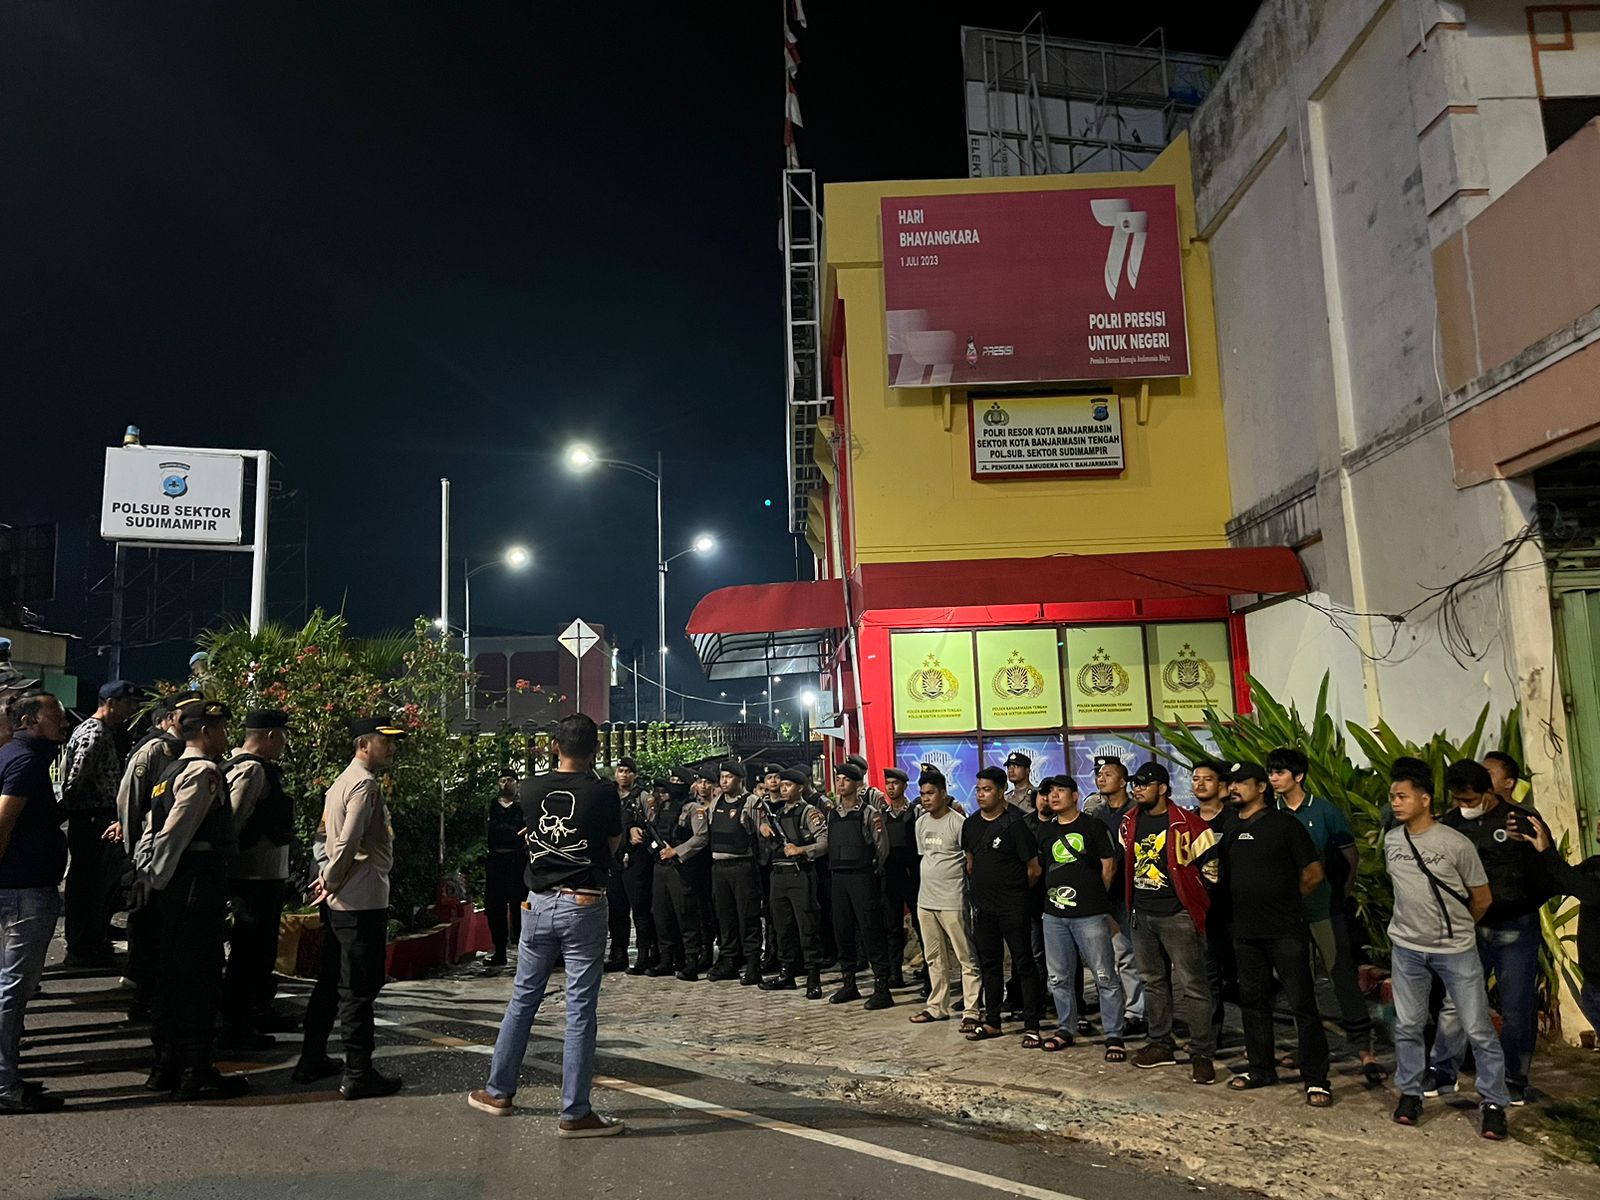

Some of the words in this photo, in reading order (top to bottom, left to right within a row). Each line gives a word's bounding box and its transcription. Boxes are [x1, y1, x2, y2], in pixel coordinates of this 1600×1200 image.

[898, 209, 924, 225] HARI
[900, 228, 980, 247] BHAYANGKARA
[900, 257, 904, 267] 1
[905, 256, 919, 267] JULI
[920, 255, 939, 266] 2023
[1089, 312, 1121, 330] POLRI
[1124, 310, 1166, 328] PRESISI
[1088, 333, 1127, 351] UNTUK
[1129, 332, 1170, 350] NEGERI
[983, 428, 1006, 437] POLRI
[1007, 427, 1034, 437] RESOR
[1035, 426, 1055, 436] KOTA
[1057, 424, 1112, 435] BANJARMASIN
[977, 439, 1008, 448] SEKTOR
[1009, 438, 1030, 448] KOTA
[1031, 436, 1086, 447] BANJARMASIN
[1088, 434, 1120, 444] TENGAH
[1026, 448, 1057, 457] SEKTOR
[1059, 446, 1108, 456] SUDIMAMPIR
[112, 502, 170, 515] POLSUB
[174, 505, 231, 518] SEKTOR
[125, 516, 217, 531] SUDIMAMPIR
